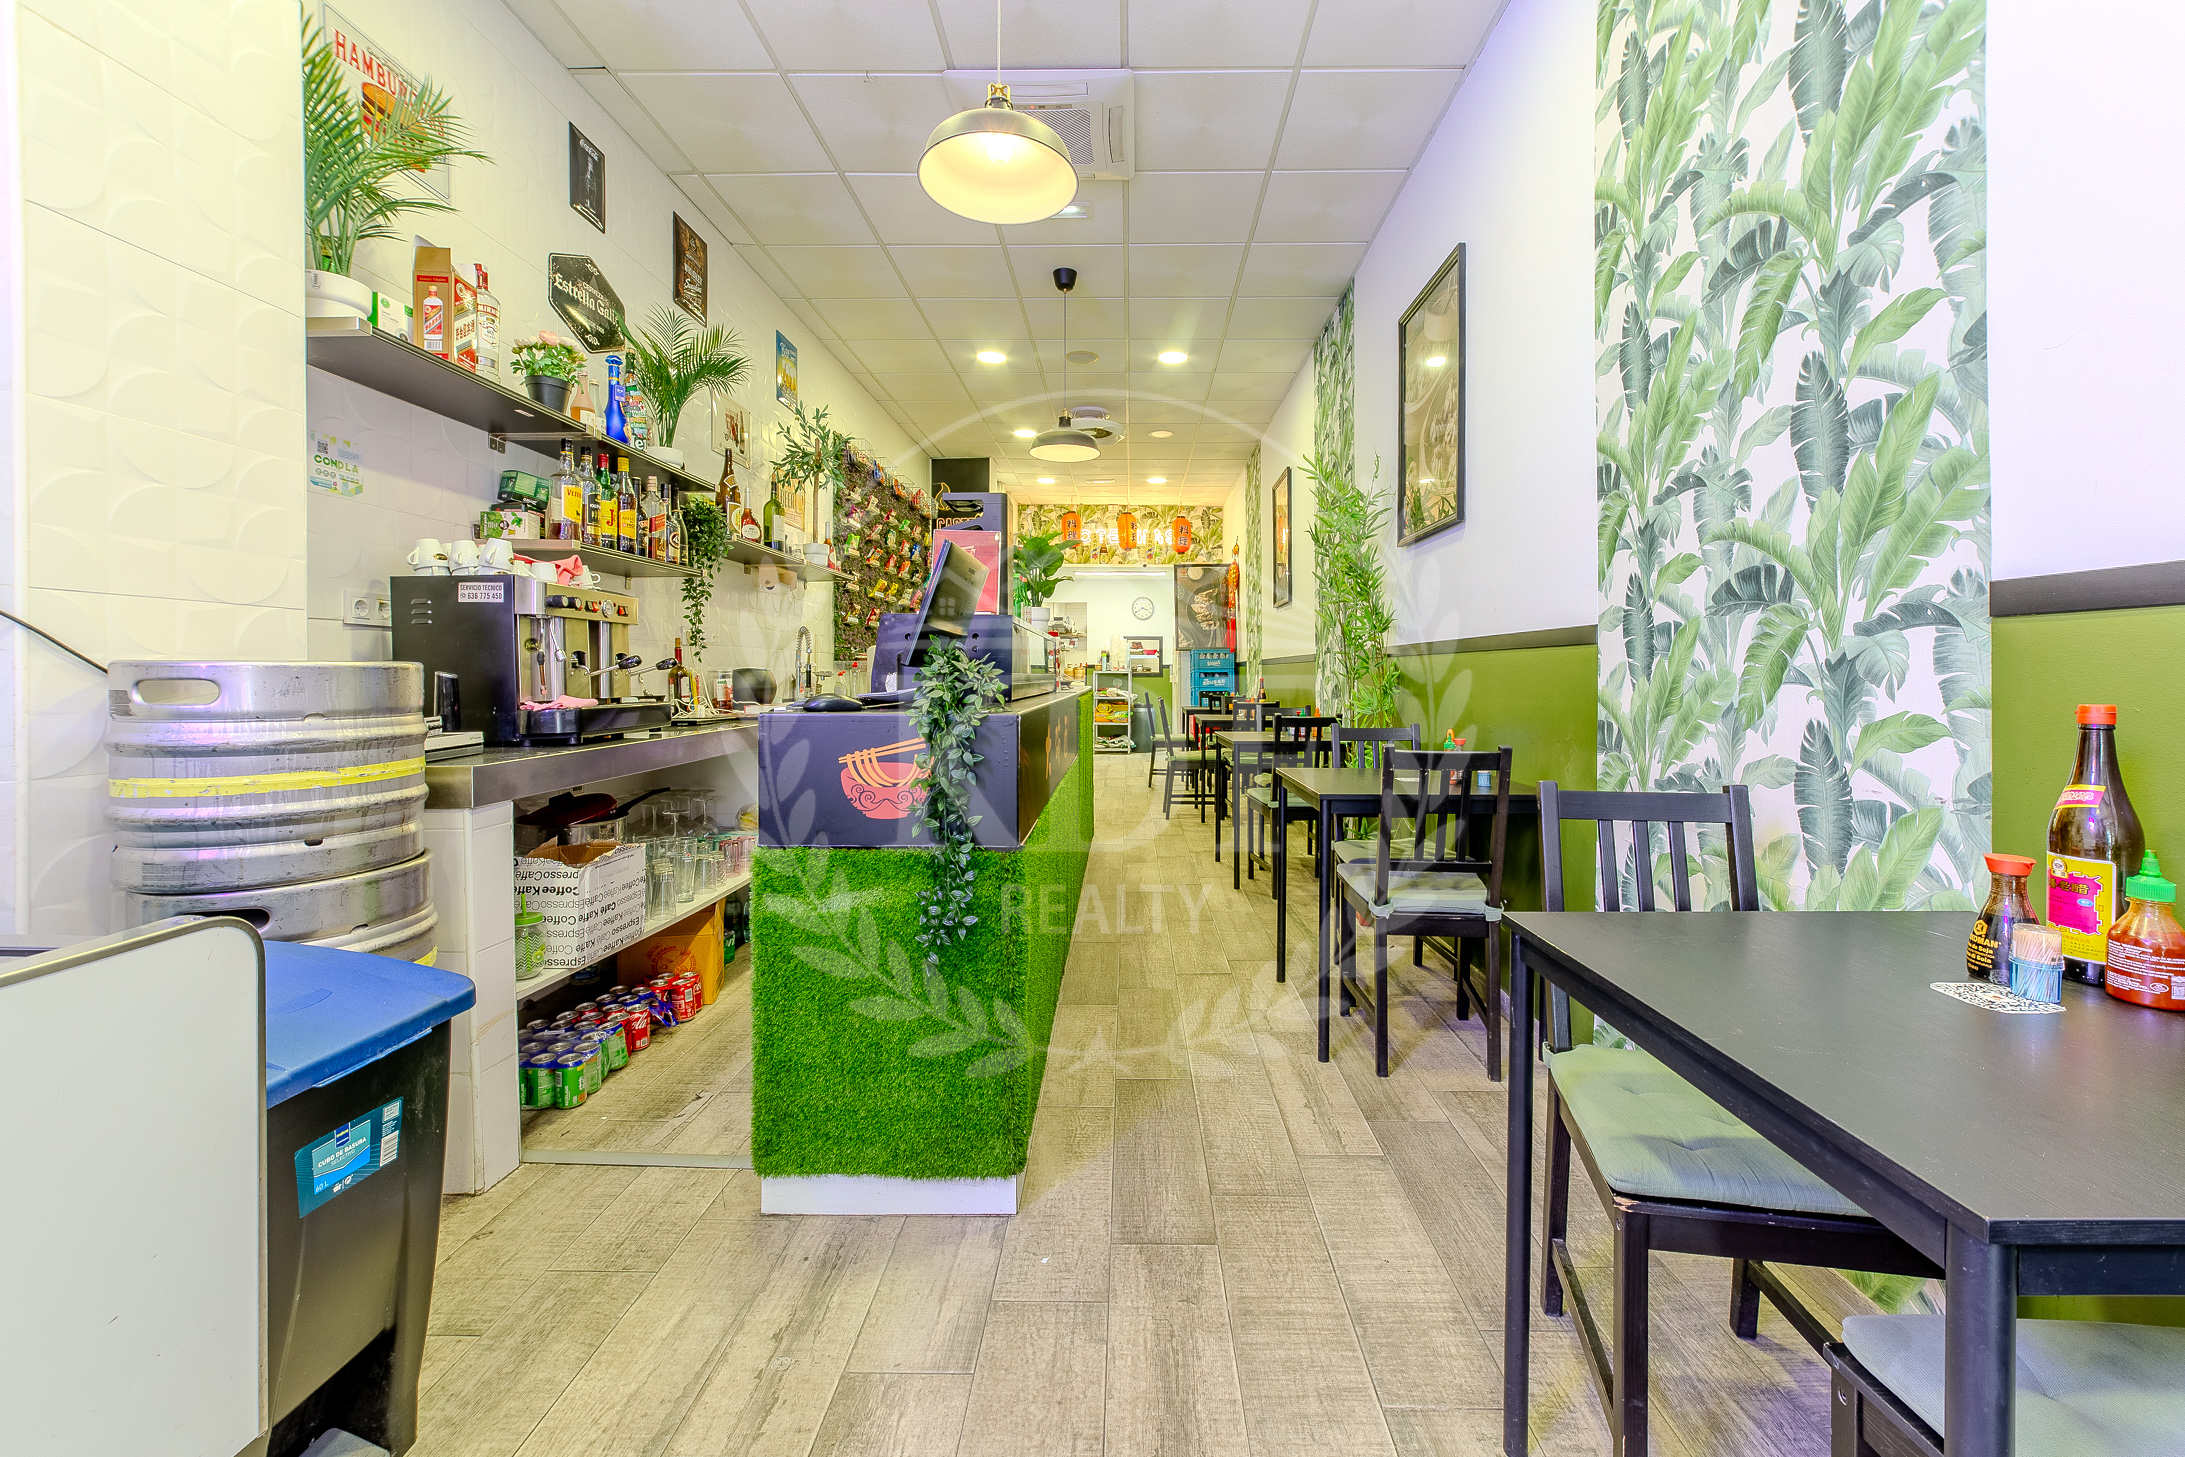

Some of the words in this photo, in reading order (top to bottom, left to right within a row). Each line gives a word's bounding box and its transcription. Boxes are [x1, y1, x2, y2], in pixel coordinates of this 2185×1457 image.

[554, 273, 596, 311] Estrella
[596, 300, 619, 326] Gali
[1178, 525, 1189, 546] 料理
[482, 583, 502, 591] TÉCNICO
[467, 592, 478, 600] 636
[479, 592, 490, 600] 775
[491, 592, 502, 600] 450
[611, 916, 640, 935] Espresso
[545, 944, 573, 955] Coffe
[317, 1154, 335, 1168] CUBO
[335, 1149, 344, 1158] DE
[344, 1136, 367, 1153] BASURA
[315, 1183, 324, 1193] 60
